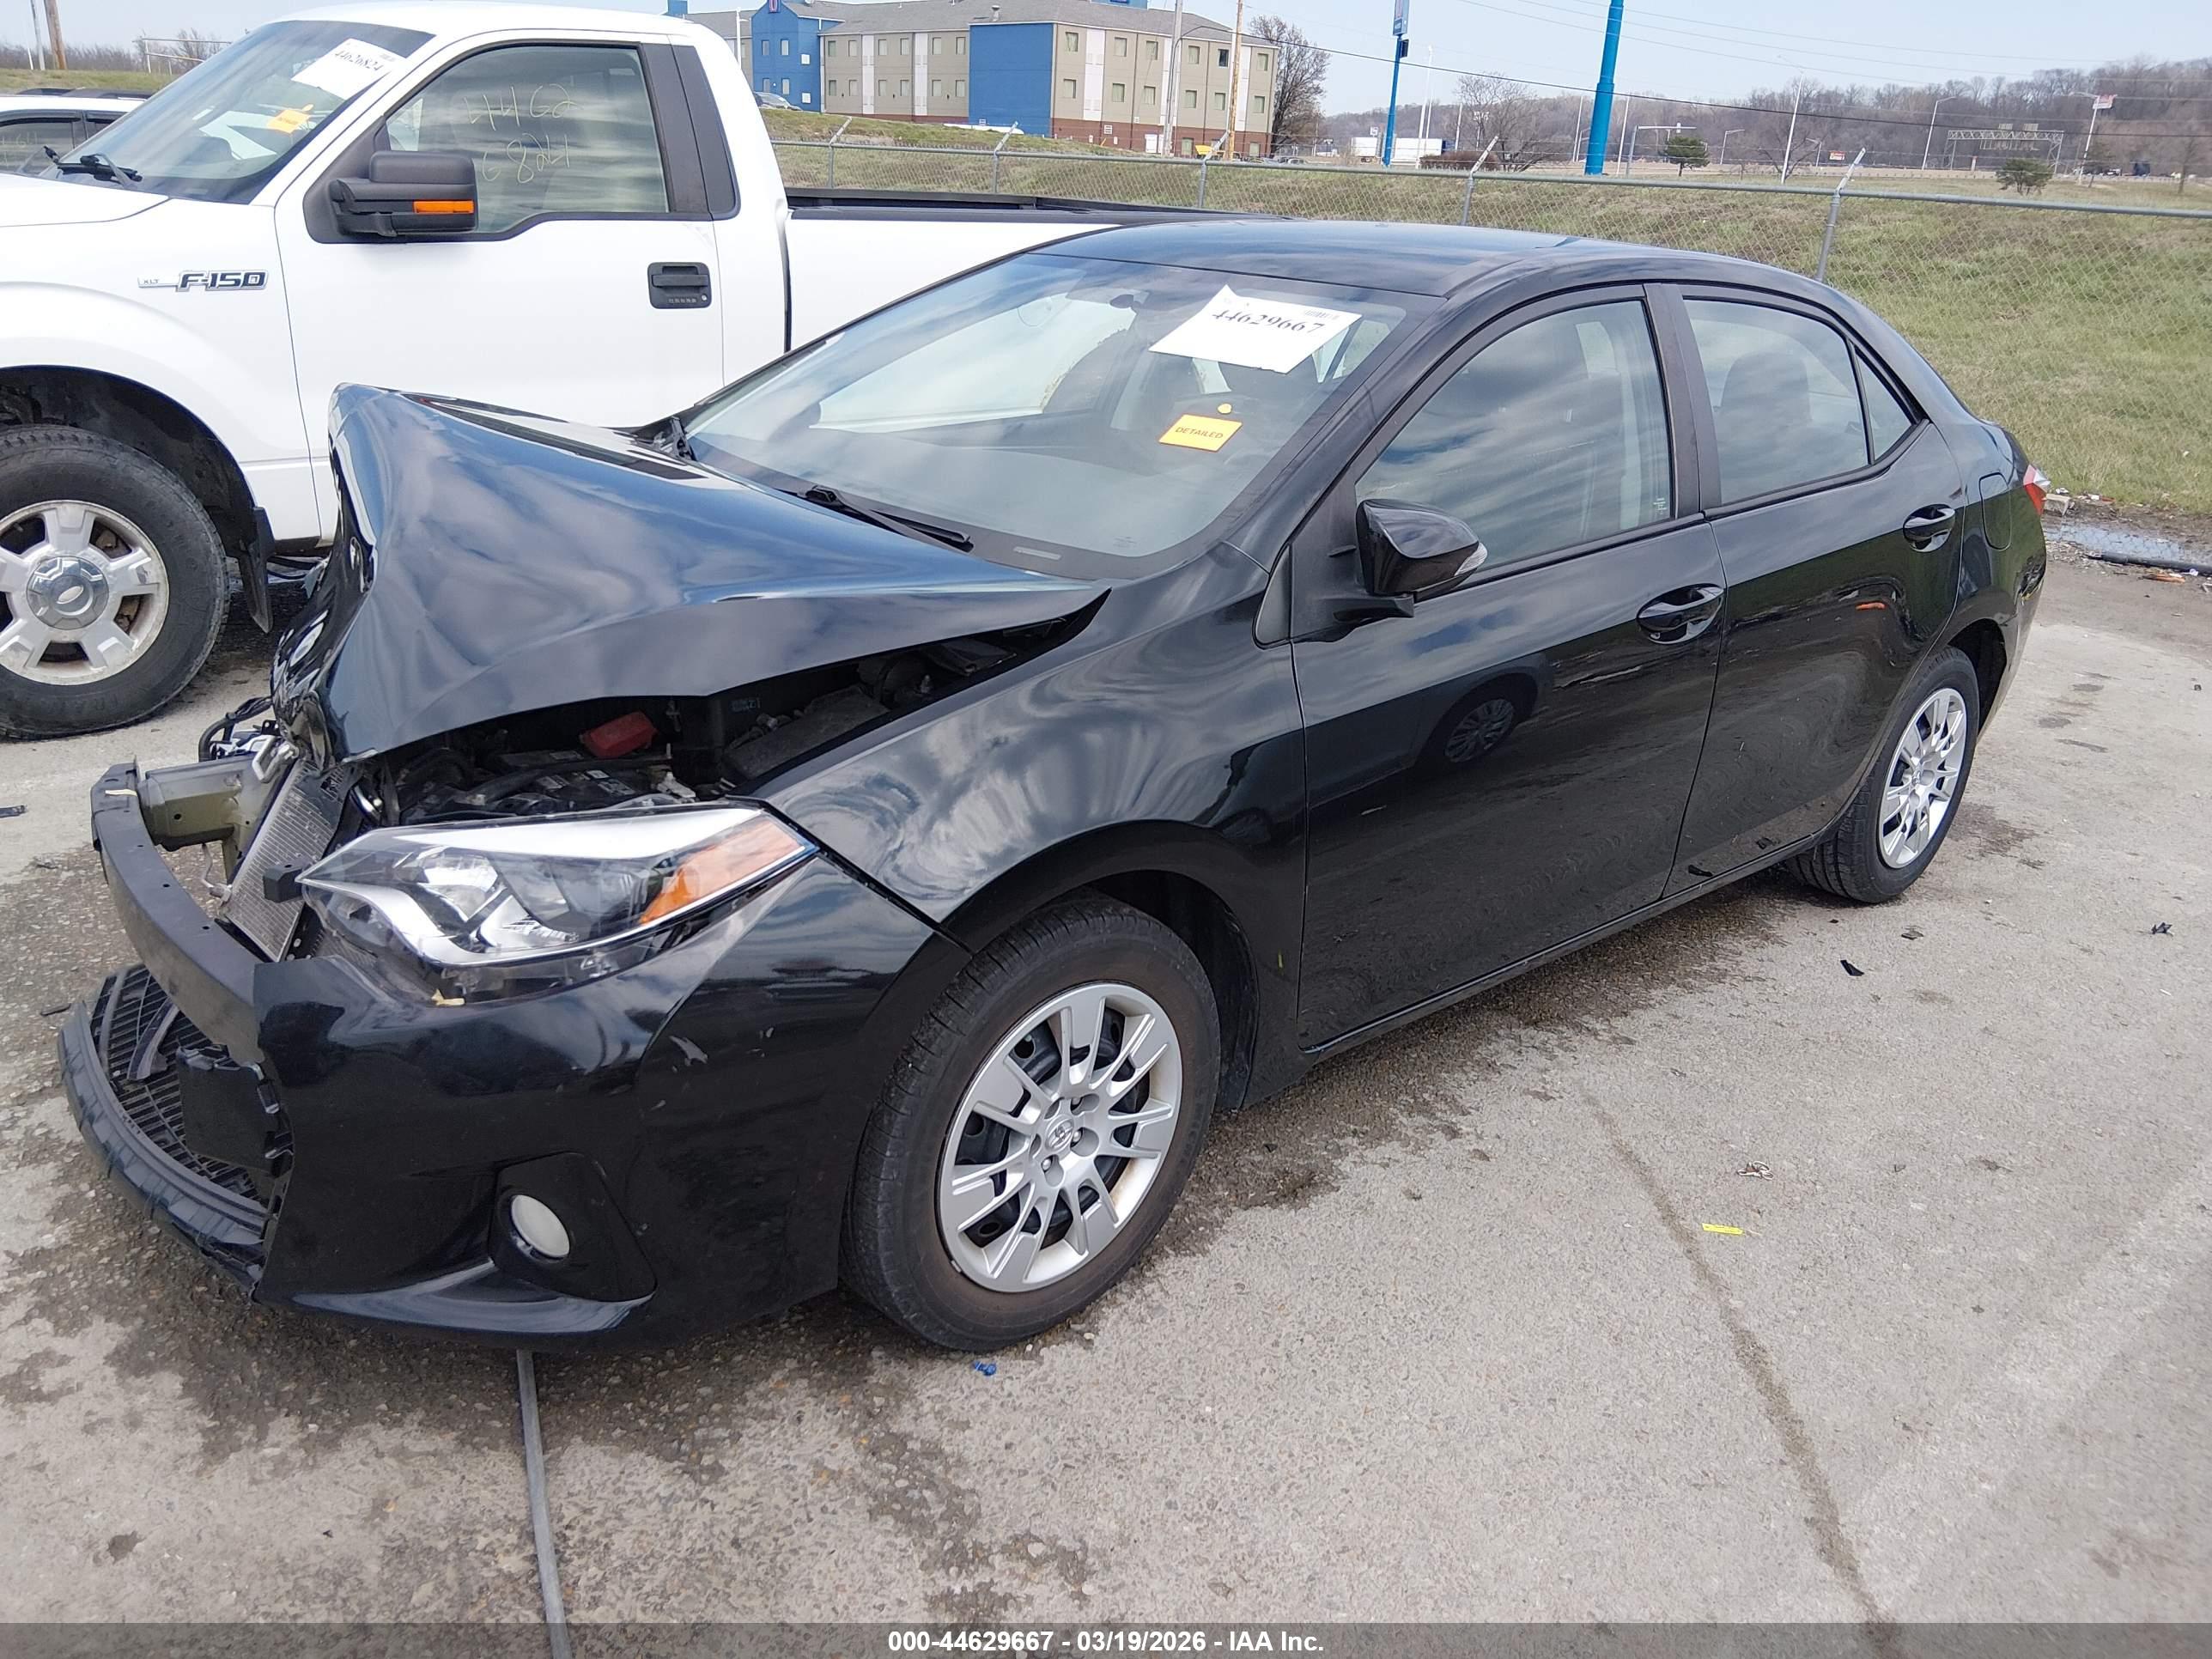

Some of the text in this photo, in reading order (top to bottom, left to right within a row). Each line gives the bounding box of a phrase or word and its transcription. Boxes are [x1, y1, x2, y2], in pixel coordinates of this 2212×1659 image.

[179, 271, 266, 289] F-150
[1212, 310, 1325, 332] 44629667
[1175, 427, 1224, 439] DETAILED
